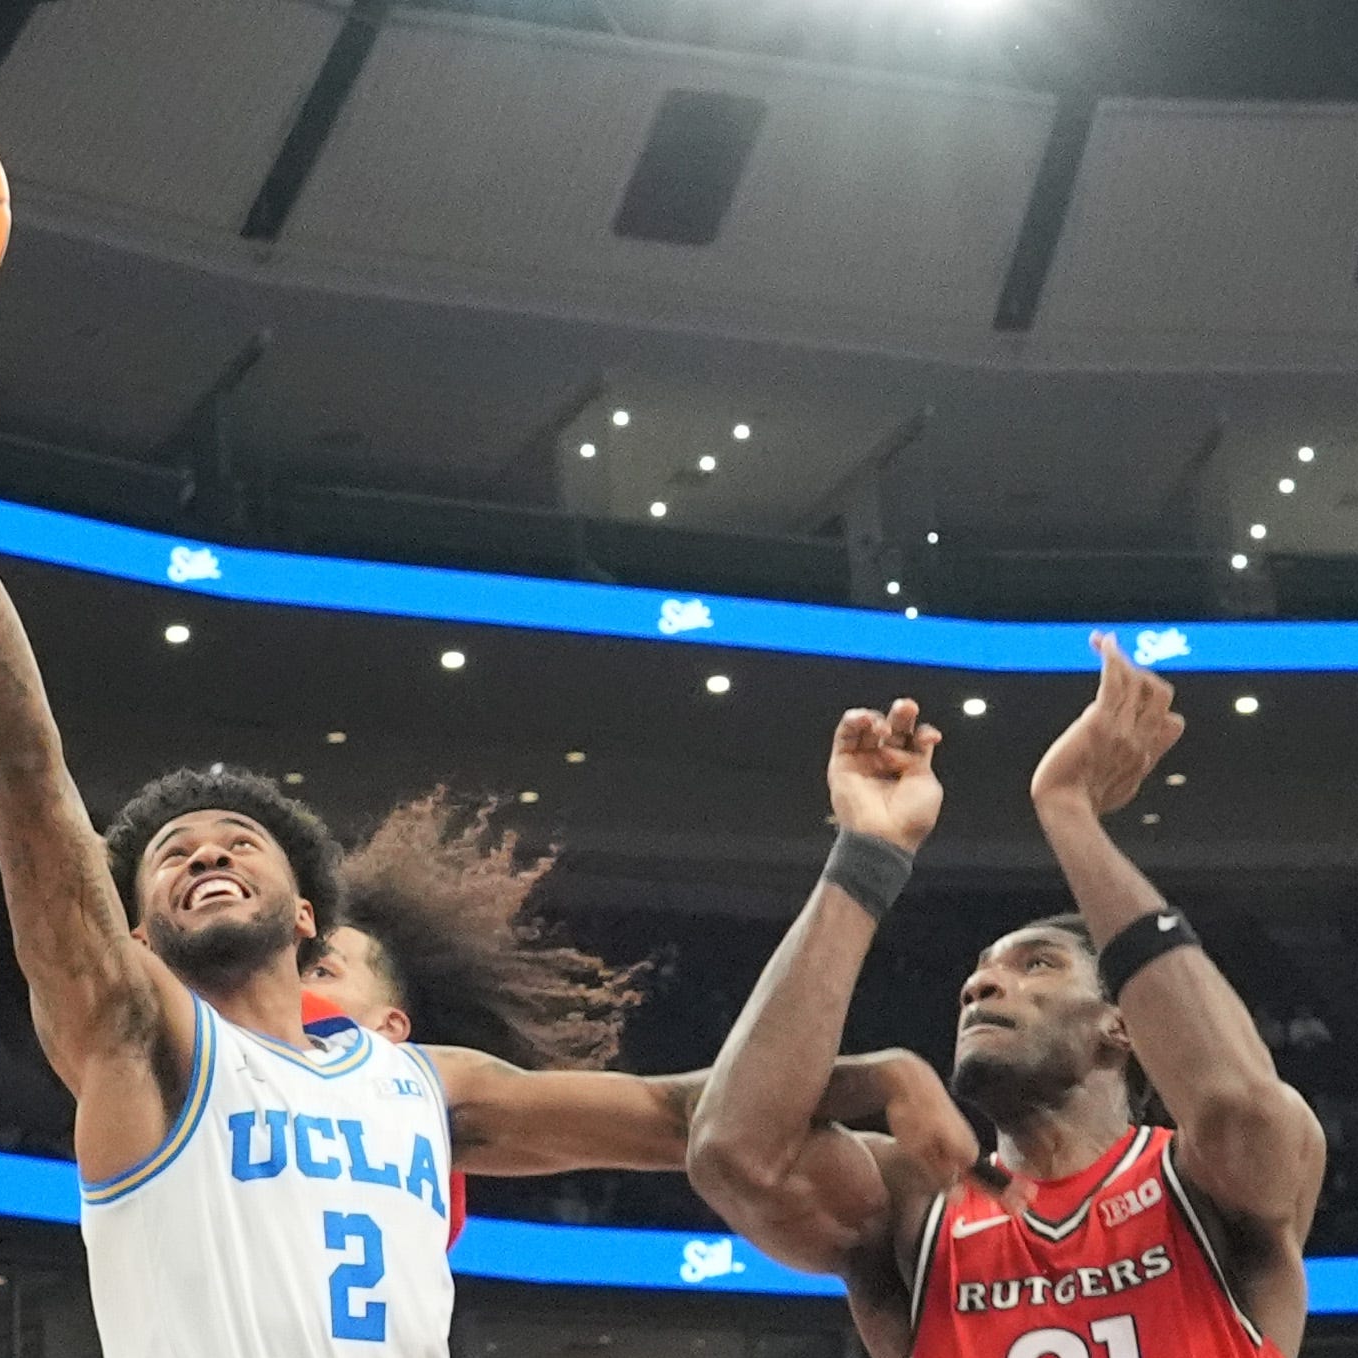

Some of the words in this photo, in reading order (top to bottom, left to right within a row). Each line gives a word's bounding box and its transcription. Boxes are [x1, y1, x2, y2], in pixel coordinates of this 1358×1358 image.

[229, 1109, 446, 1220] UCLA
[323, 1210, 386, 1342] 2
[956, 1244, 1173, 1312] RUTGERS
